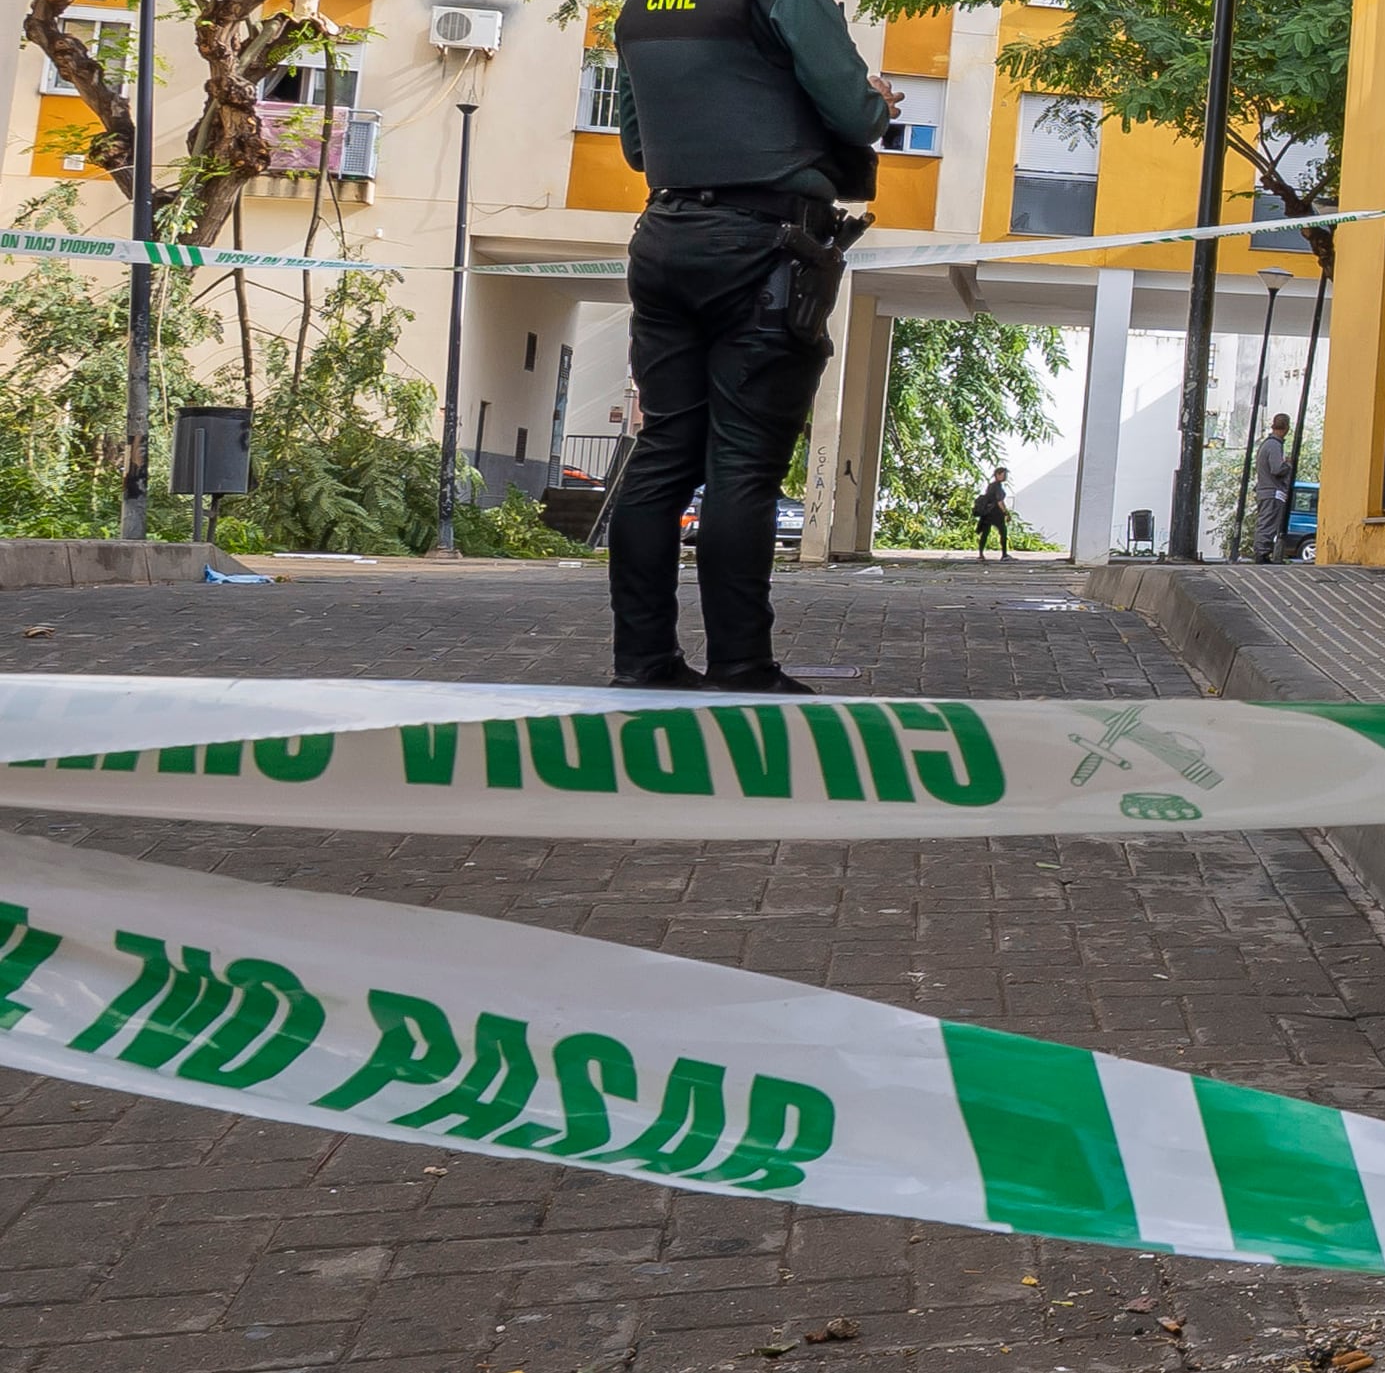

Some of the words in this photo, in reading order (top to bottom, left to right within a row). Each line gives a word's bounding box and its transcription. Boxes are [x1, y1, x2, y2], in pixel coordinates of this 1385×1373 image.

[1, 233, 20, 248] NO
[24, 235, 57, 251] CIVIL
[59, 239, 115, 255] GUARDIA
[215, 252, 259, 265] PASAR
[400, 702, 1007, 806] GUARDIA
[66, 930, 326, 1090] NO
[309, 988, 837, 1194] PASAR
